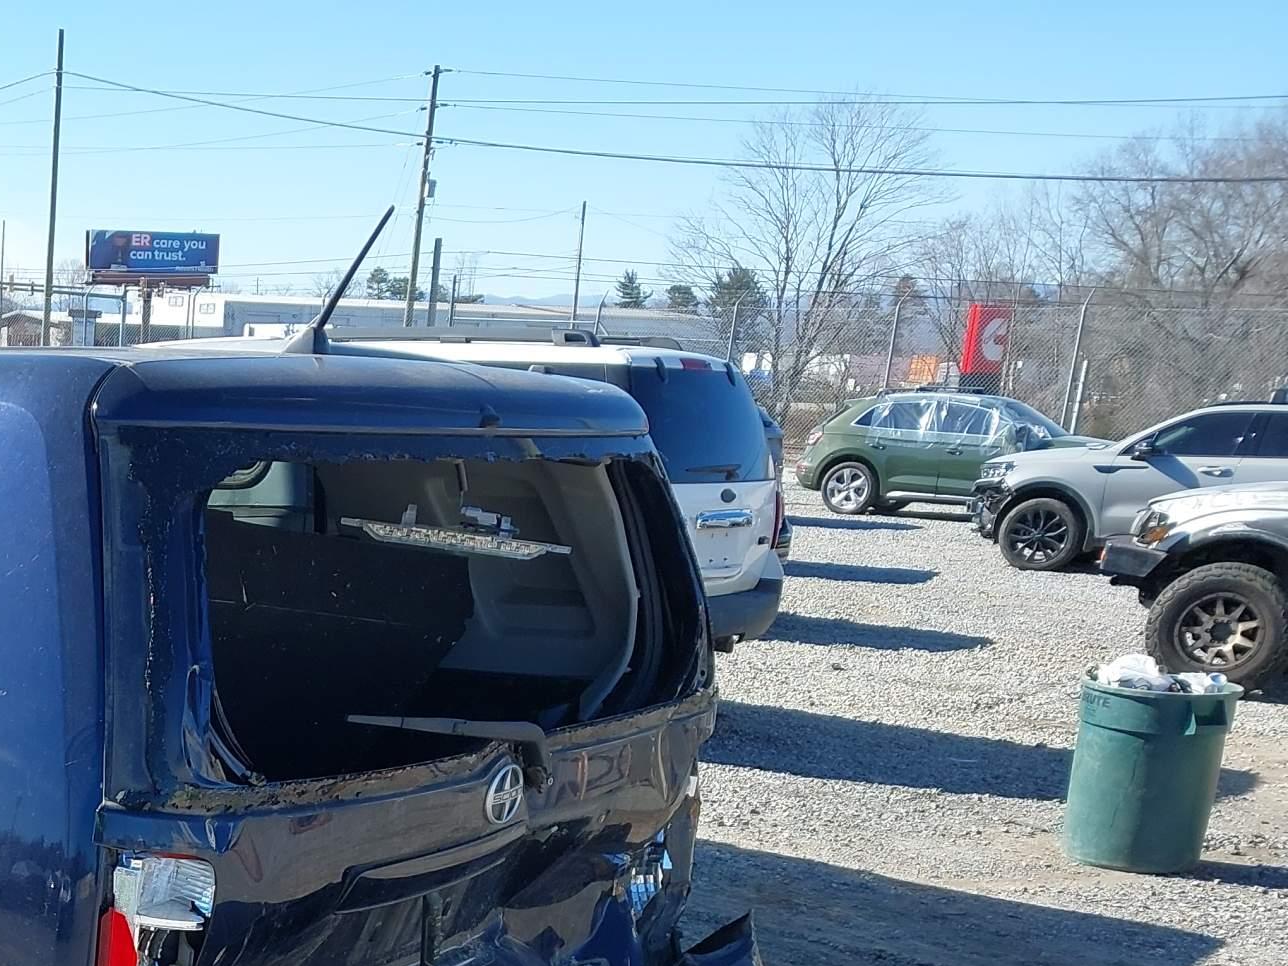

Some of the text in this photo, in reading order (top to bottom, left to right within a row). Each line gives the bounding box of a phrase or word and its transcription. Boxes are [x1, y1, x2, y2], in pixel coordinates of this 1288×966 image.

[131, 233, 206, 251] ER care you
[130, 250, 186, 261] can trust.
